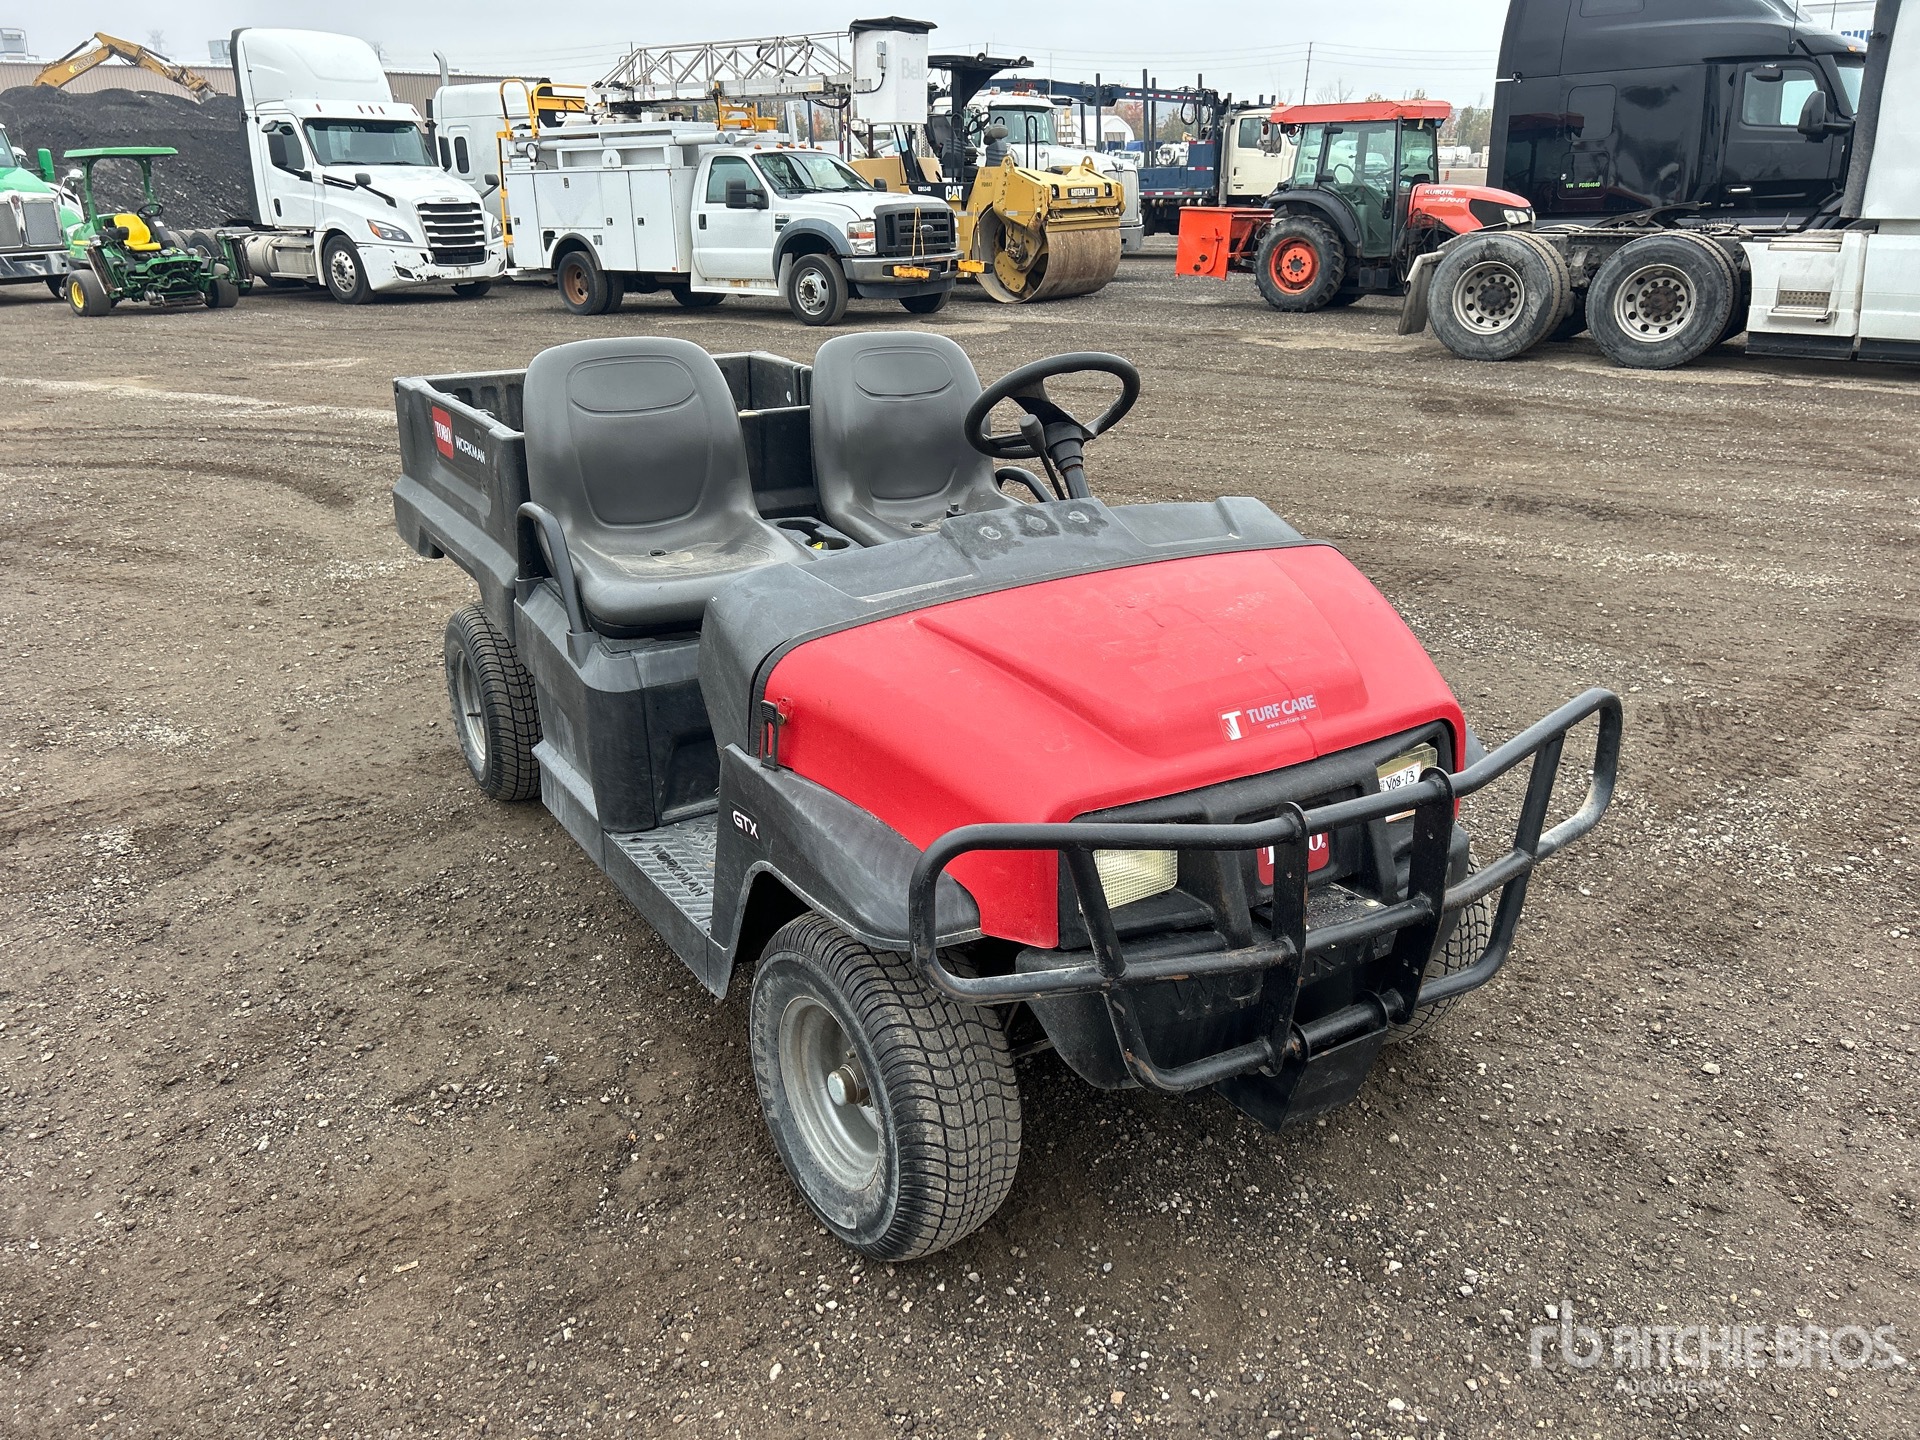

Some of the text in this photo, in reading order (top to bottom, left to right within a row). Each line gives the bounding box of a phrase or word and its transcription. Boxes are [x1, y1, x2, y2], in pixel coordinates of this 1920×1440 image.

[901, 57, 924, 80] Bell
[945, 185, 964, 201] CAT
[454, 434, 486, 465] WORKMAN
[1246, 695, 1316, 724] TURF CARE
[732, 810, 760, 840] GTX
[648, 843, 709, 897] WORKMAN
